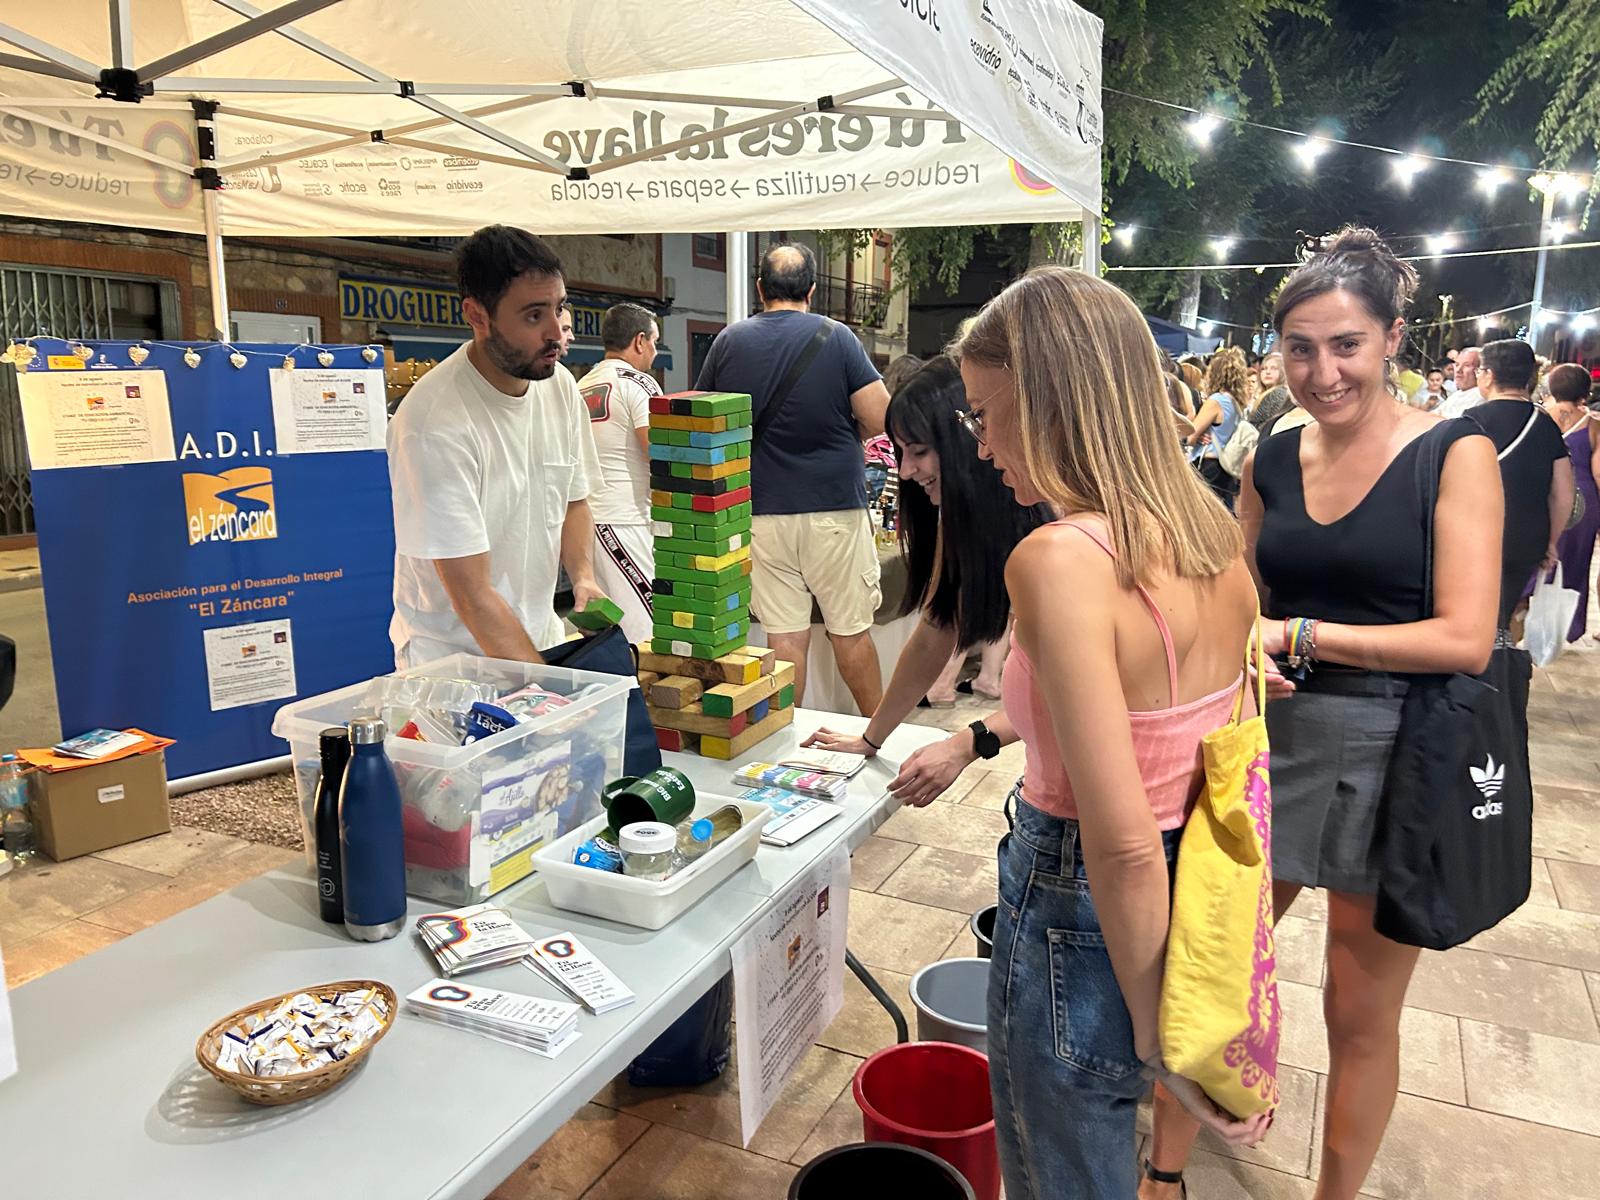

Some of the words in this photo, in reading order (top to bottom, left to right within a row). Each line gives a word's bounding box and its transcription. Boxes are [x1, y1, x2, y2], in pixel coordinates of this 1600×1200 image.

[342, 283, 469, 326] DROGUER
[180, 431, 273, 460] A.D.I.
[127, 585, 197, 604] Asociación
[201, 582, 227, 597] para
[231, 580, 241, 592] el
[244, 573, 300, 590] Desarrollo
[303, 568, 343, 584] Integral
